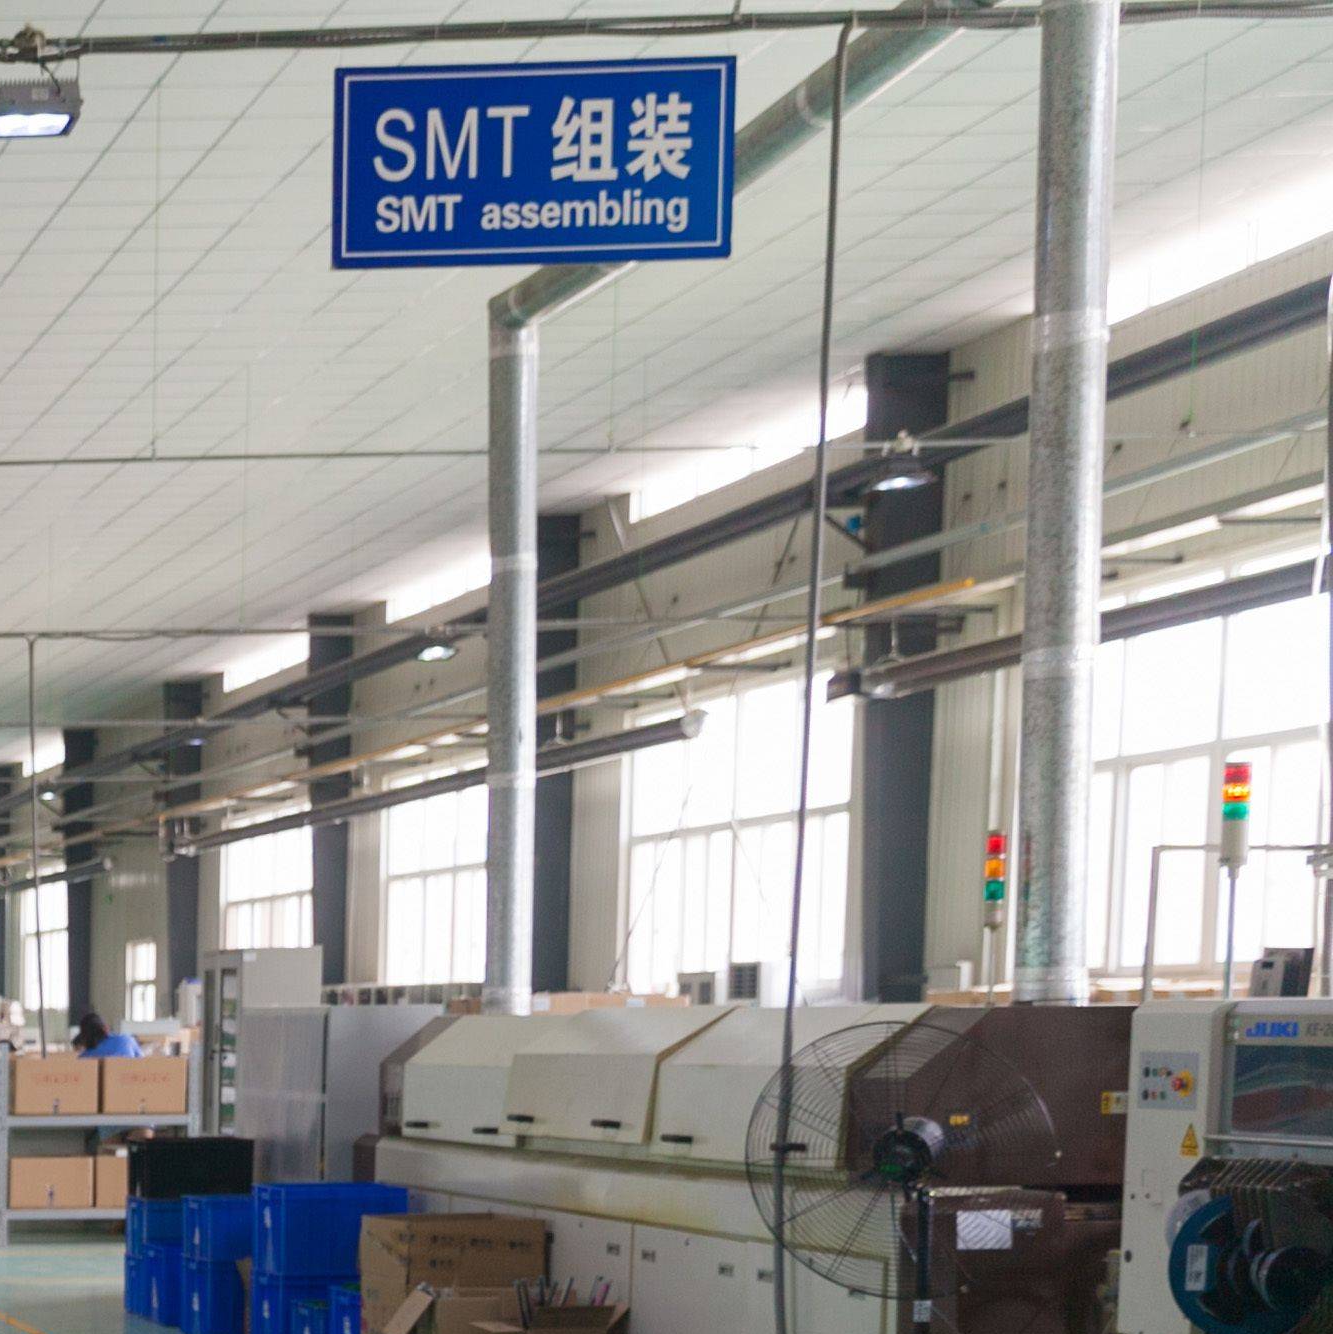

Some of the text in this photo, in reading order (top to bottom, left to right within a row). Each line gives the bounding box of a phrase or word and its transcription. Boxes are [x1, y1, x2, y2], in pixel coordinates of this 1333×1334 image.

[373, 91, 693, 182] SMT 组装
[375, 188, 689, 234] SMT assembling
